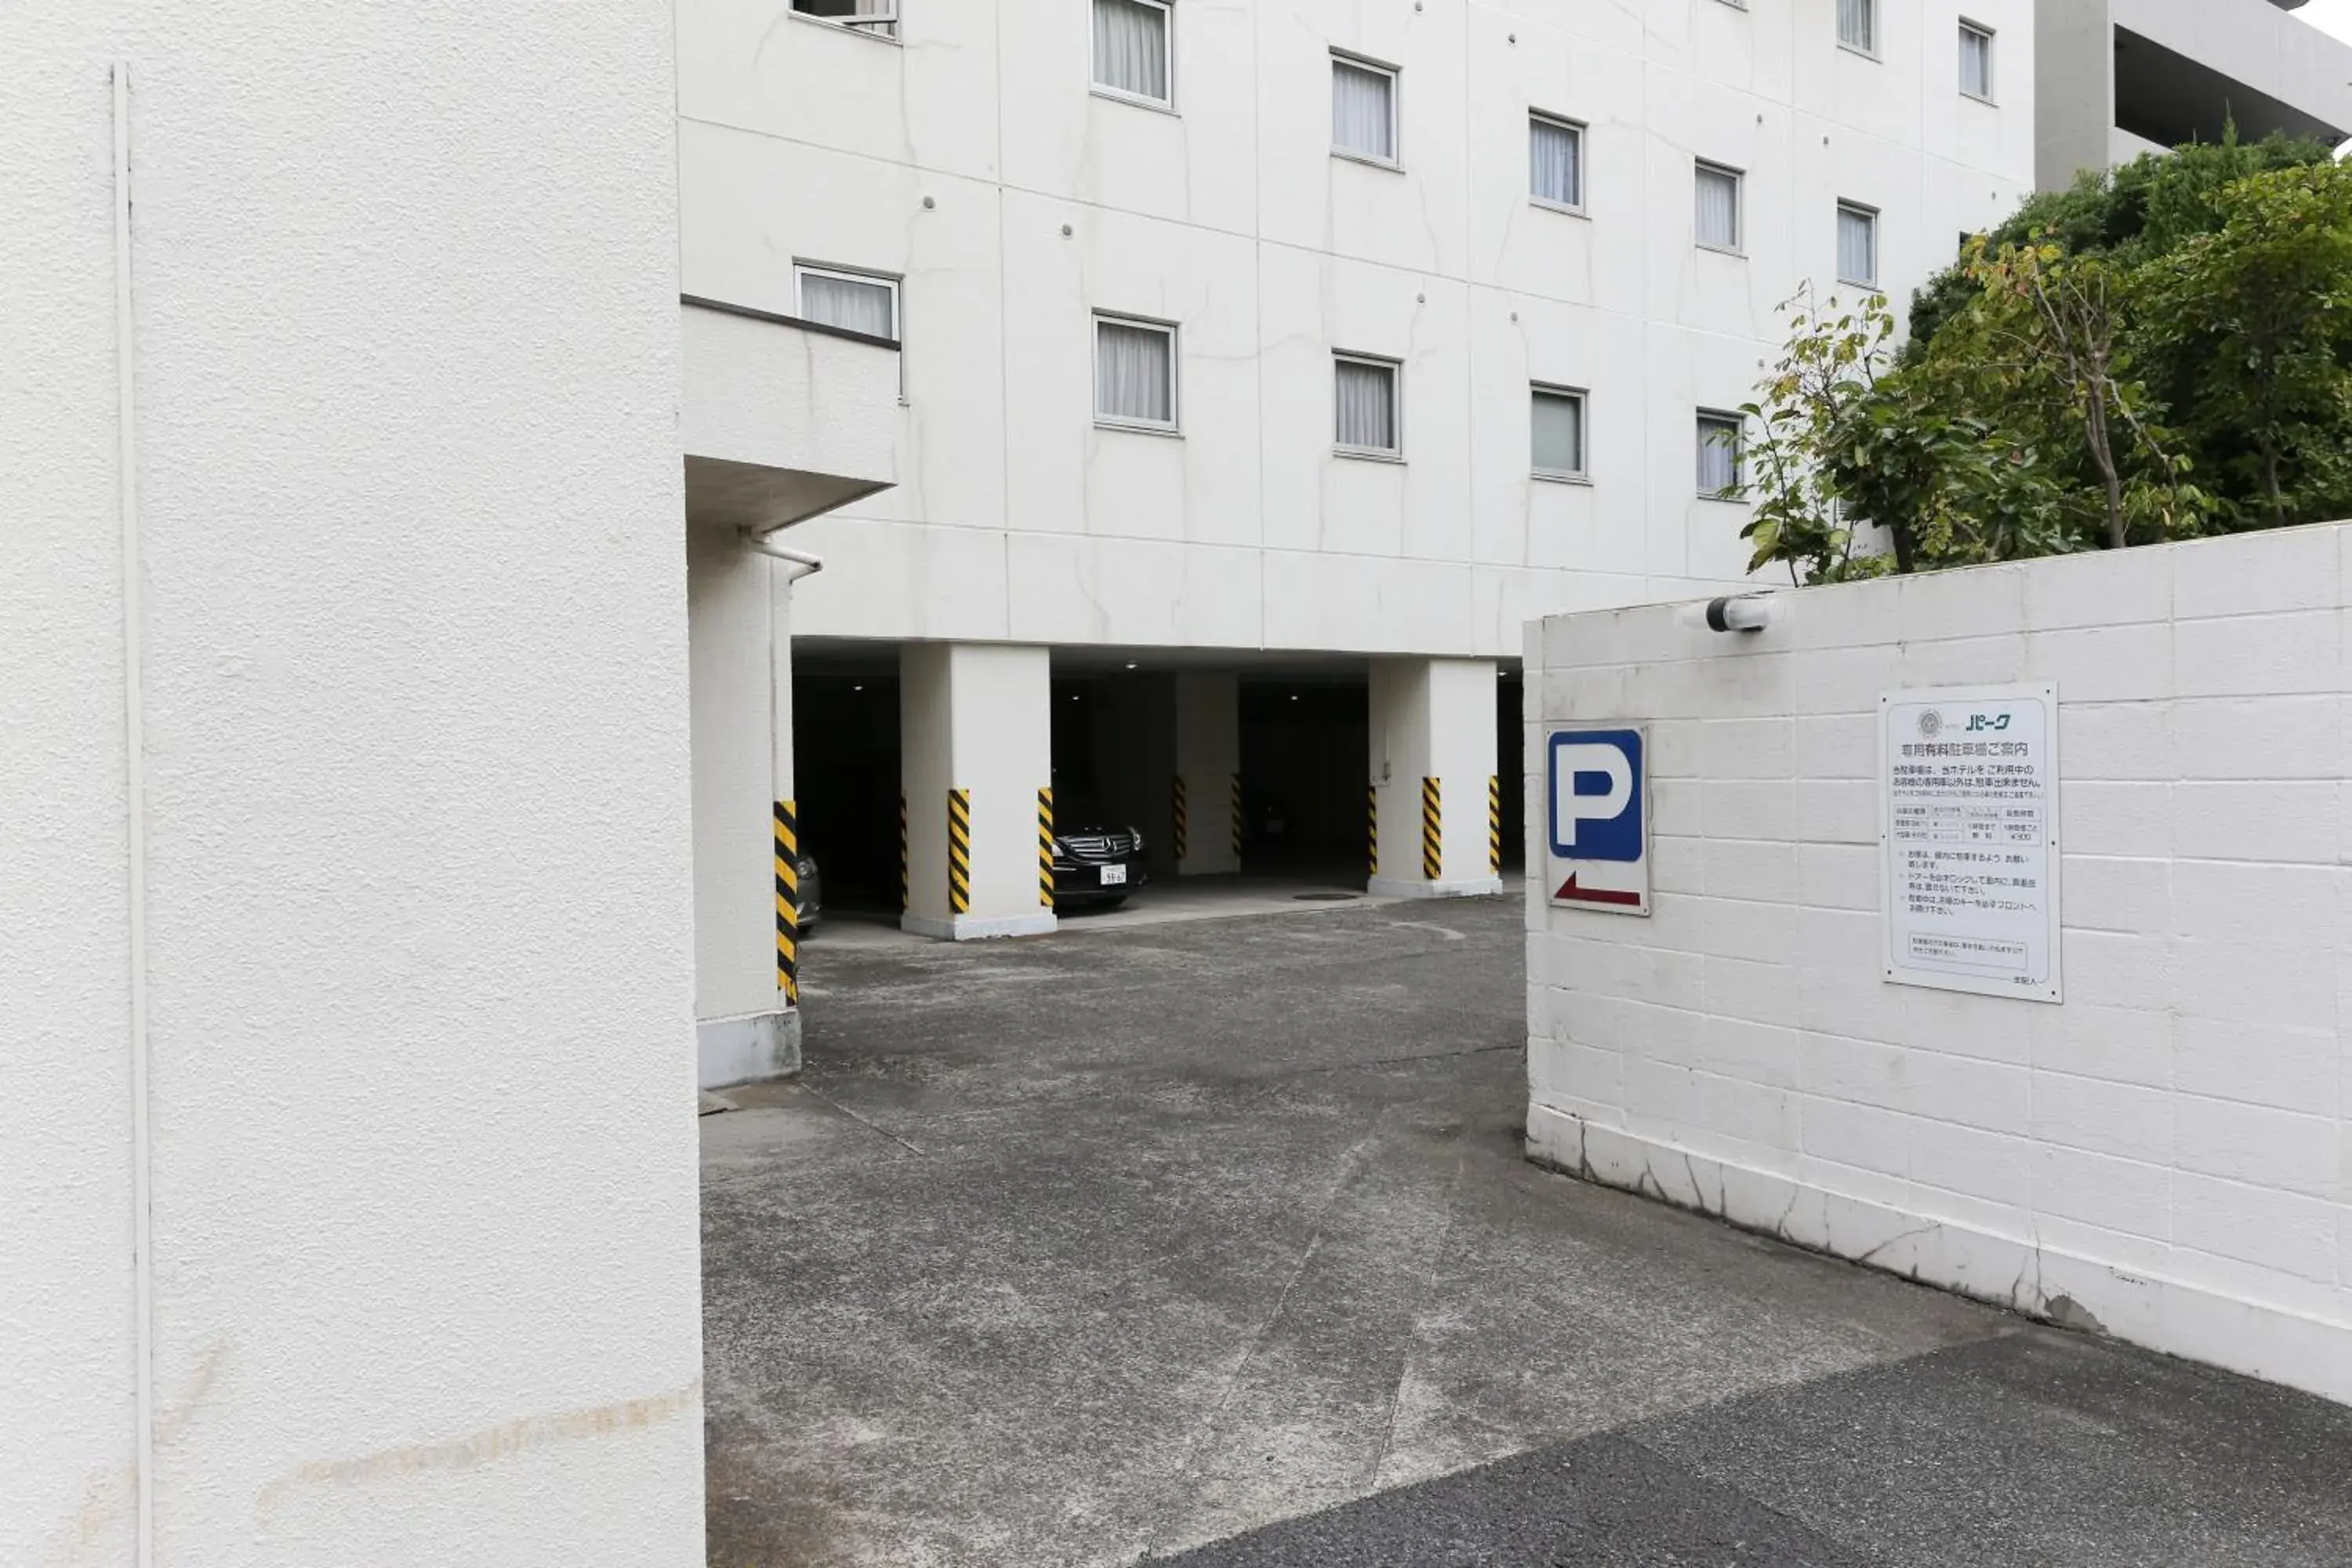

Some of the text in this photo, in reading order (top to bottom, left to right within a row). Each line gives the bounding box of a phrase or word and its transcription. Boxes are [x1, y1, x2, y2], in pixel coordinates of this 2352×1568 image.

[1901, 742, 2028, 757] 専用有料駐車場ご案内
[1555, 743, 1633, 846] P
